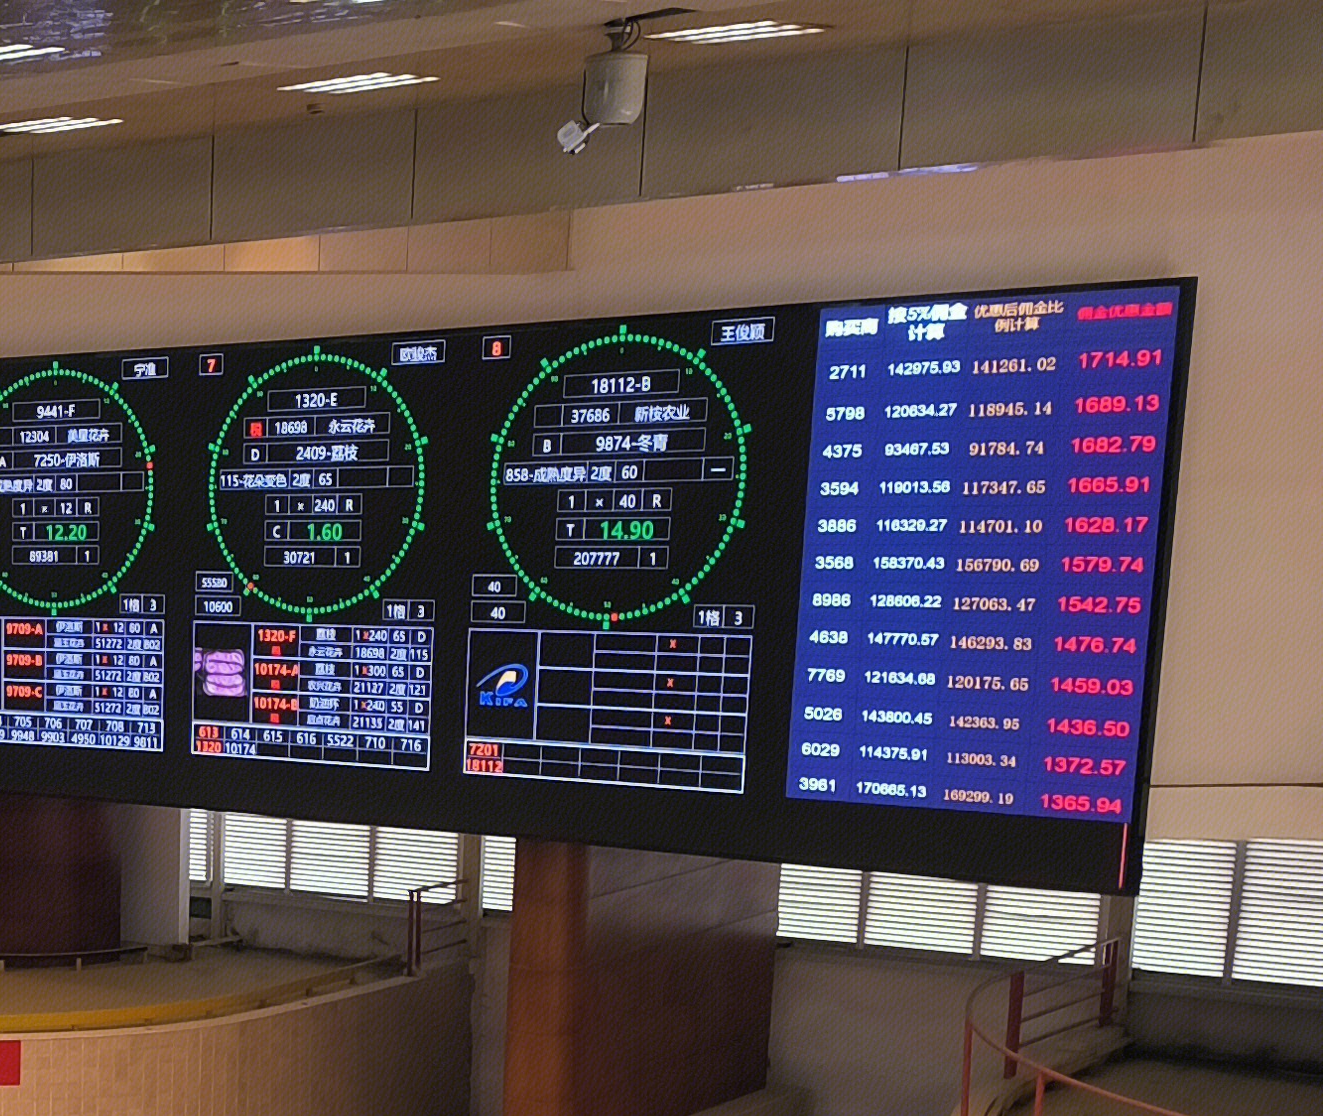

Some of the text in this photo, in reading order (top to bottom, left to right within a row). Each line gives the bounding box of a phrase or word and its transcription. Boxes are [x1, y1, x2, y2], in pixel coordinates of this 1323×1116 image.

[207, 359, 216, 372] 7
[829, 365, 866, 379] 2711
[887, 360, 960, 377] 142975.93
[1079, 349, 1162, 368] 1714.91
[295, 392, 338, 408] 1320-E
[826, 406, 865, 421] 5798
[884, 403, 957, 418] 120634.27
[1075, 395, 1160, 413] 1689.13
[571, 409, 610, 423] 37686
[251, 449, 259, 460] D
[822, 444, 862, 458] 4375
[884, 442, 949, 456] 93467.53
[1071, 436, 1156, 453] 1682.79
[319, 474, 332, 485] 65
[622, 466, 637, 479] 60
[820, 482, 859, 495] 3594
[879, 480, 951, 494] 119013.56
[1068, 477, 1151, 494] 1665.91
[61, 502, 73, 514] 12
[315, 499, 353, 511] 240 R
[619, 495, 661, 508] 40 R
[46, 525, 87, 540] 12.20
[307, 524, 343, 540] 1.60
[601, 521, 654, 540] 14.90
[817, 520, 857, 533] 3886
[877, 519, 948, 532] 116329.27
[1065, 517, 1149, 533] 1628.17
[573, 552, 620, 565] 207777
[815, 557, 854, 570] 3568
[873, 557, 945, 570] 158370.43
[1061, 557, 1144, 573] 1579.74
[487, 581, 501, 593] 40
[812, 593, 851, 607] 8986
[870, 594, 942, 609] 128606.22
[1058, 597, 1142, 614] 1542.75
[490, 607, 505, 619] 40
[734, 611, 743, 624] 3
[393, 631, 405, 642] 65
[809, 631, 848, 645] 4638
[867, 632, 939, 647] 147770.57
[1055, 637, 1137, 654] 1476.74
[392, 666, 405, 677] 65
[807, 668, 846, 683] 7769
[864, 670, 936, 686] 121634.68
[1051, 677, 1134, 695] 1459.03
[804, 707, 843, 722] 5026
[862, 709, 933, 725] 143800.45
[1047, 718, 1131, 737] 1436.50
[231, 728, 251, 740] 614
[263, 730, 283, 742] 615
[297, 732, 316, 744] 616
[365, 736, 385, 749] 710
[401, 738, 421, 751] 716
[801, 743, 840, 757] 6029
[859, 745, 928, 761] 114375.91
[1044, 756, 1126, 775] 1372.57
[799, 778, 836, 792] 3961
[856, 781, 927, 798] 170665.13
[1041, 795, 1122, 814] 1365.94
